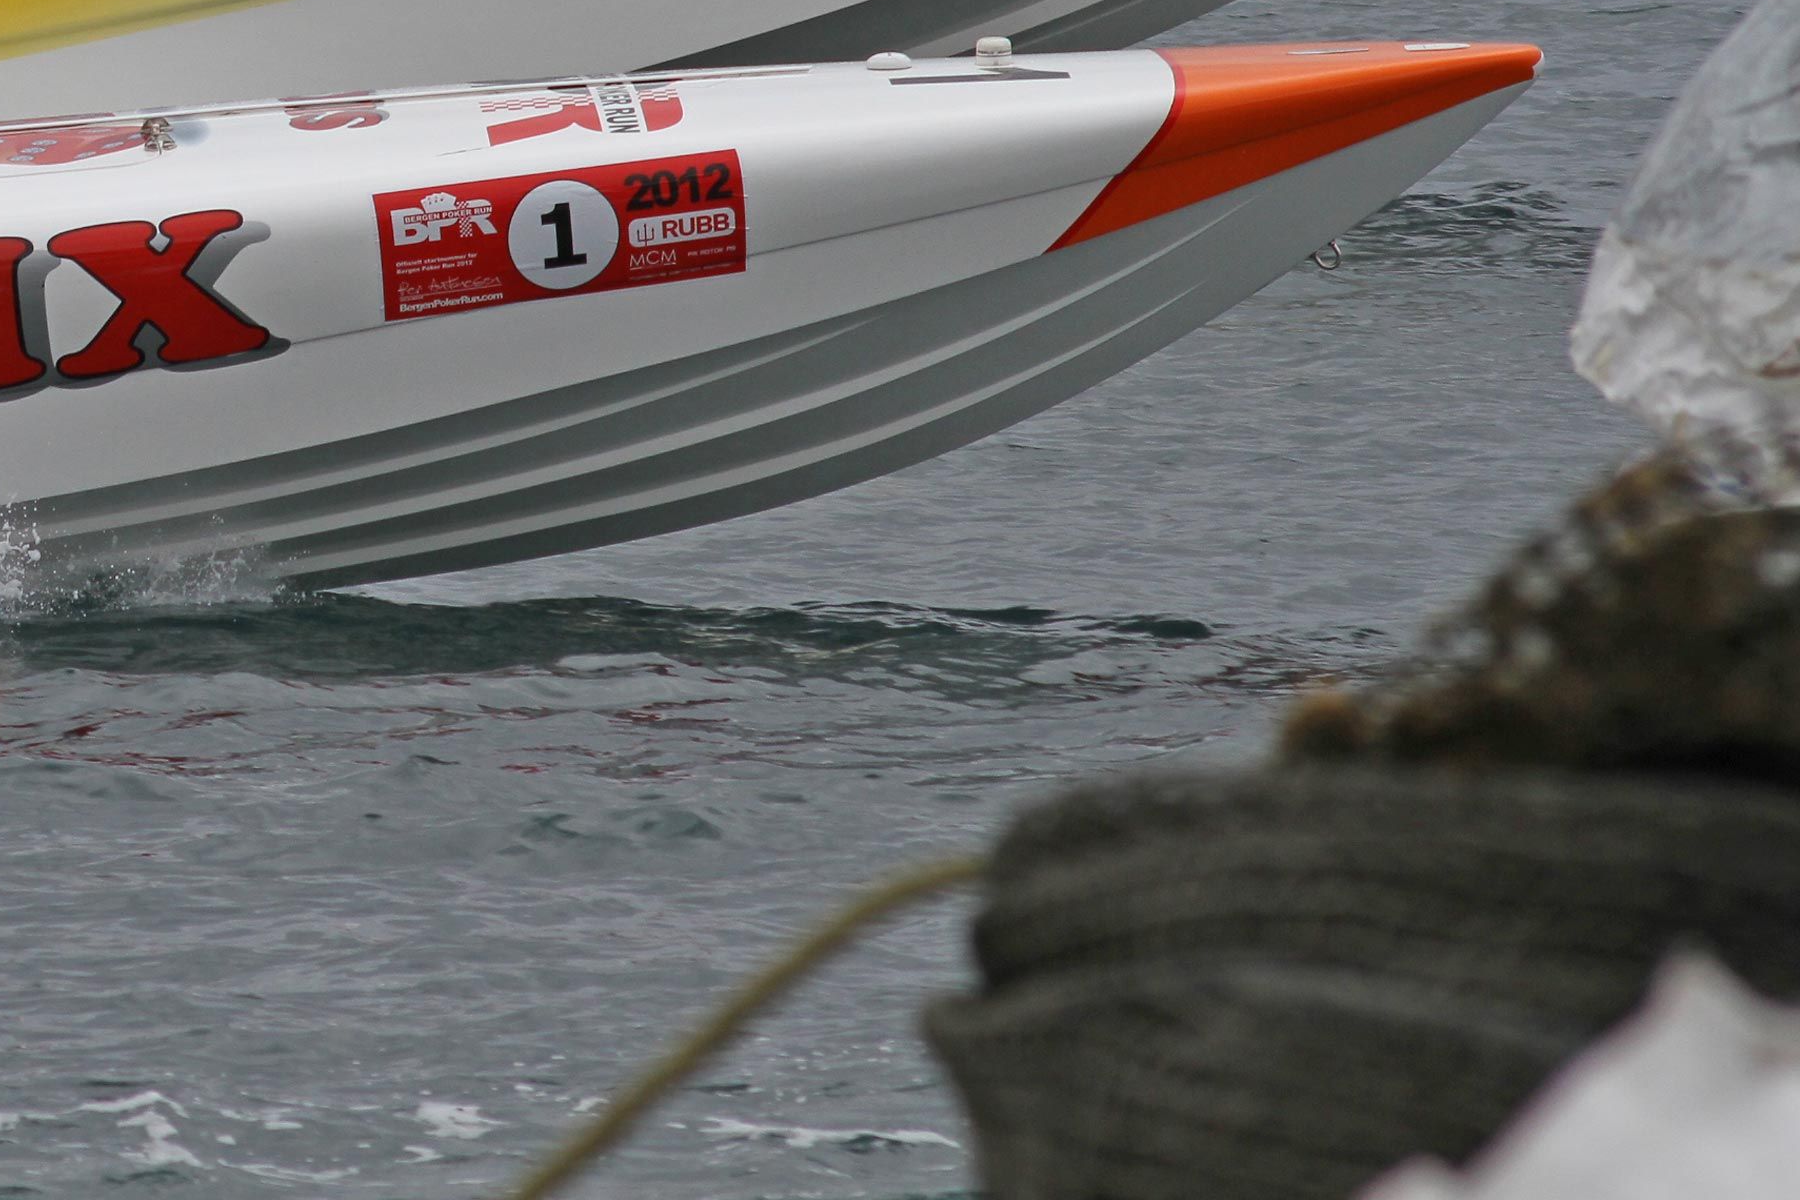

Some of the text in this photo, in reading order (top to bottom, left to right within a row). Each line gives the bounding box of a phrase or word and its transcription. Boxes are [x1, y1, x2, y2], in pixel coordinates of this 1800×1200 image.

[604, 107, 641, 133] RUN
[624, 162, 734, 212] 2012
[404, 206, 493, 224] BERGEN POKER RUN
[662, 213, 730, 239] RUBB
[540, 202, 588, 270] 1
[630, 249, 677, 267] MCM
[399, 292, 504, 312] BergenPokerRun.com
